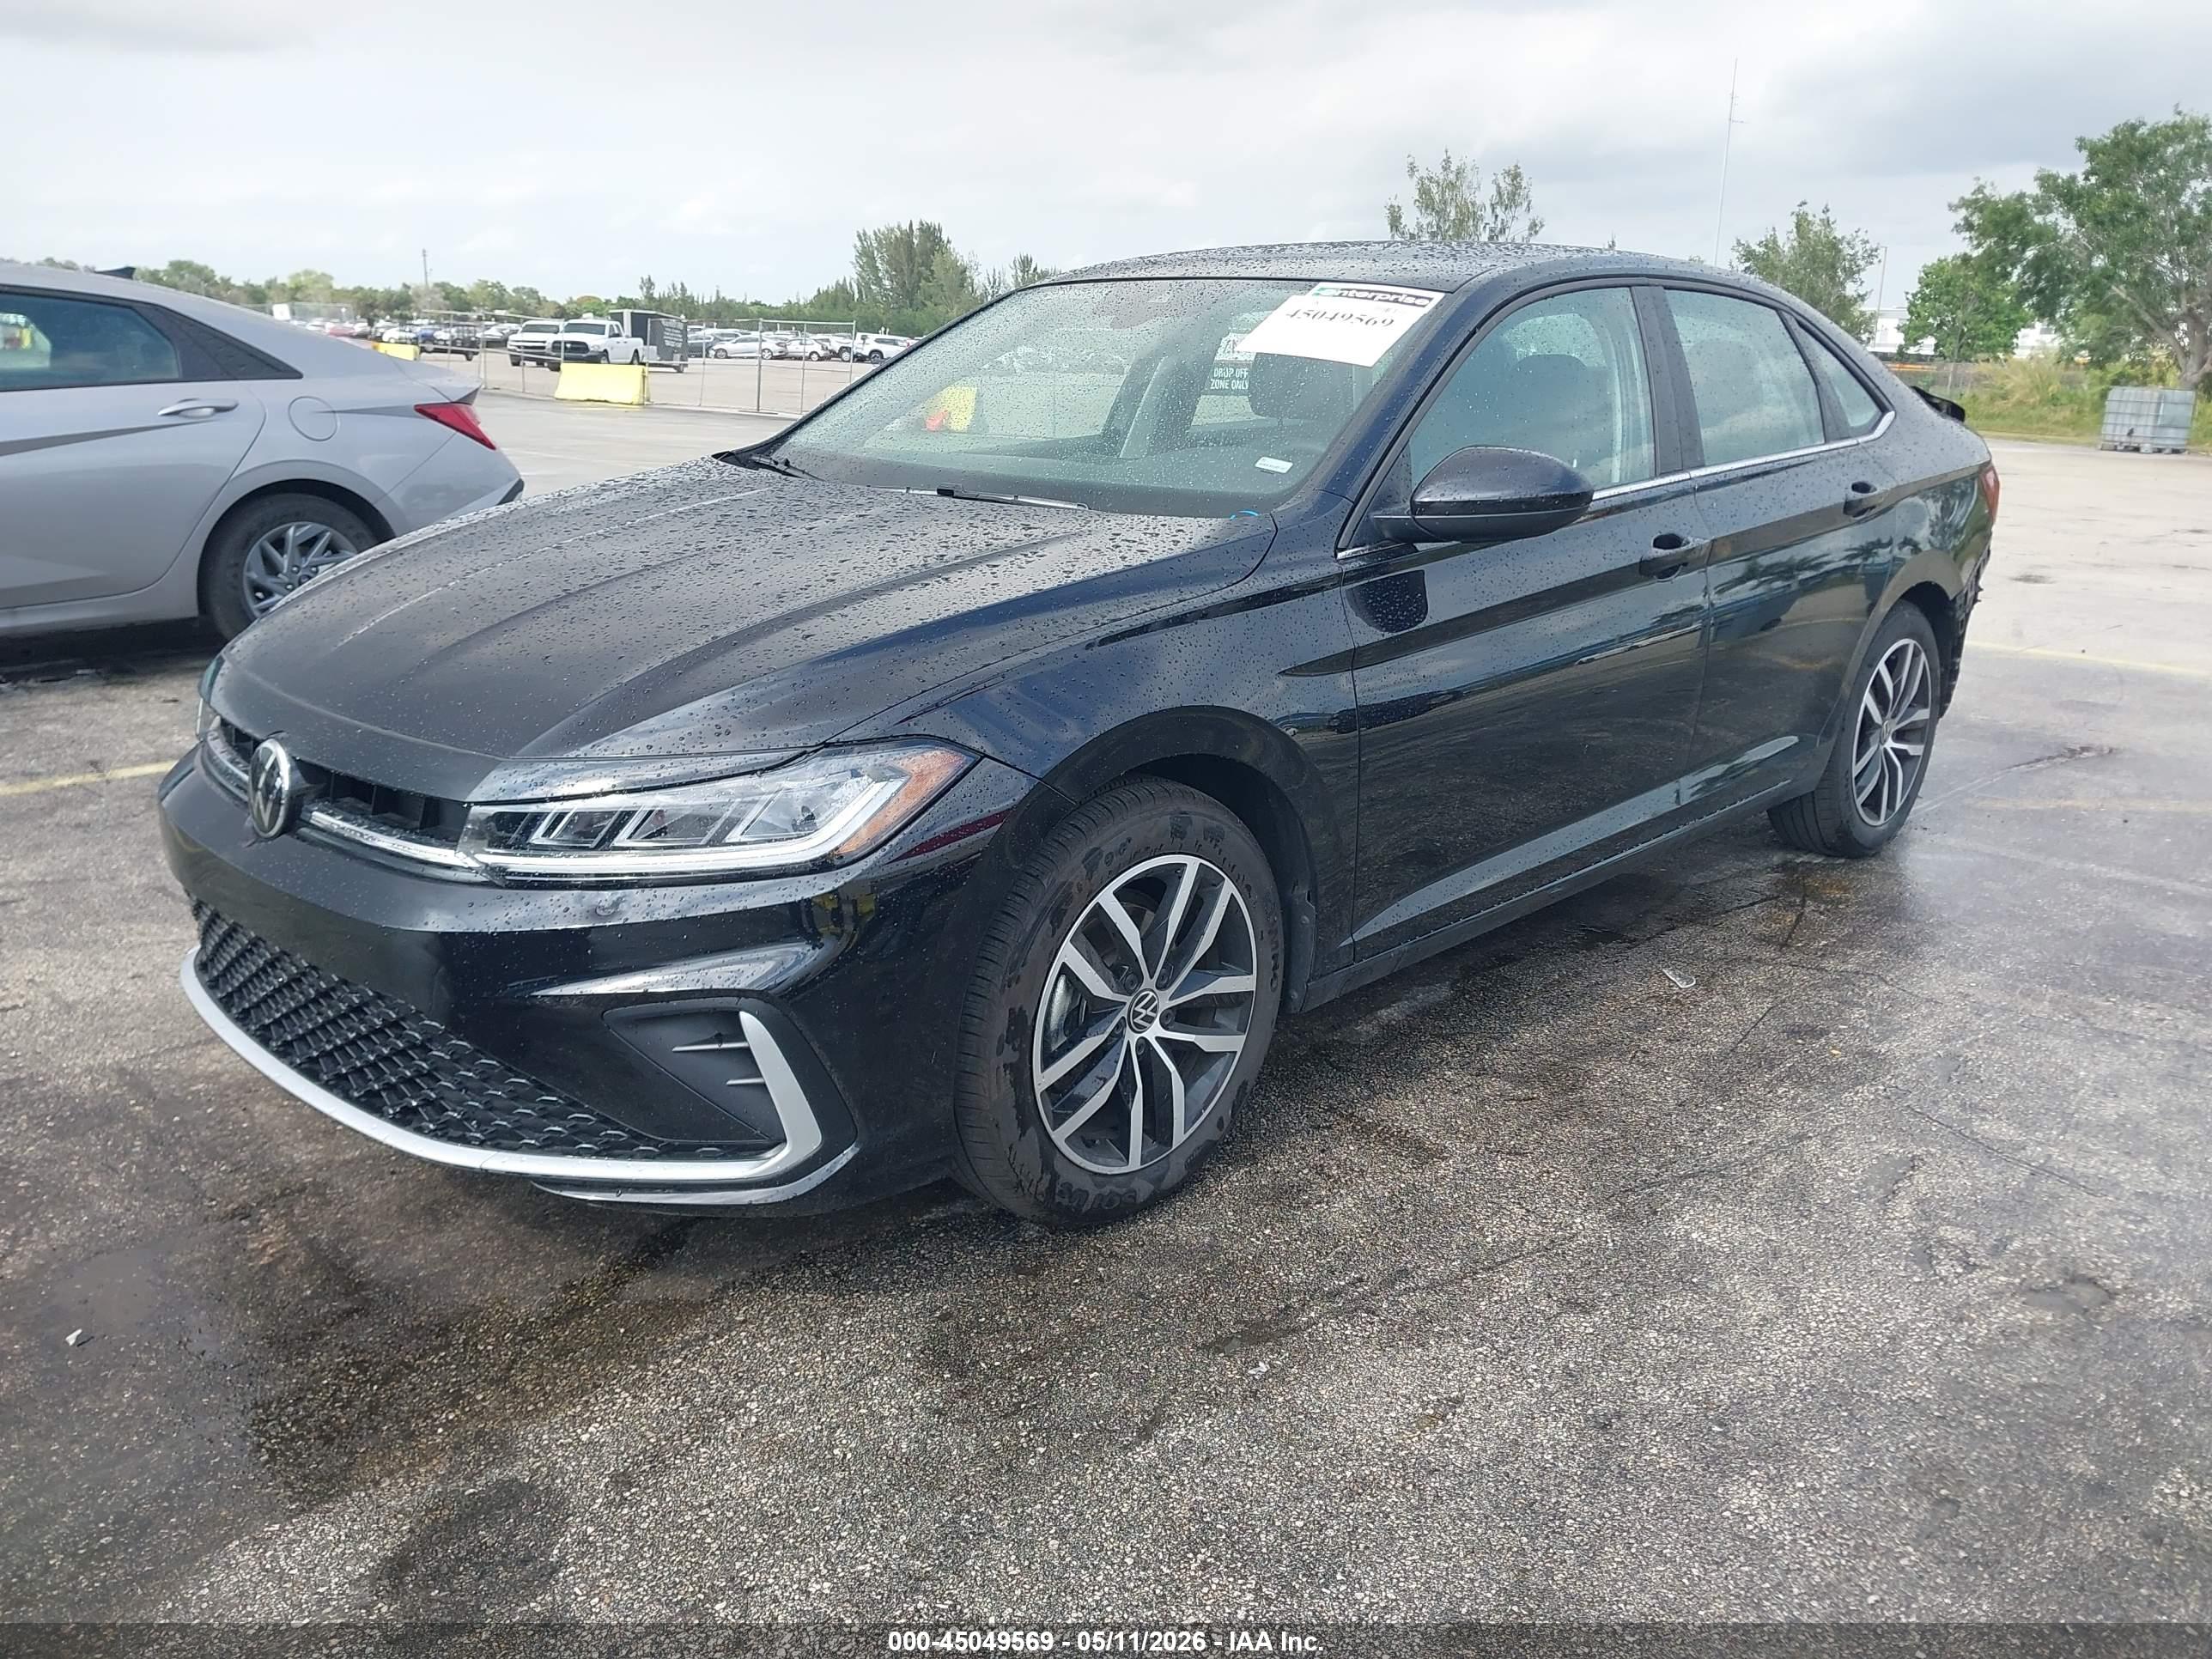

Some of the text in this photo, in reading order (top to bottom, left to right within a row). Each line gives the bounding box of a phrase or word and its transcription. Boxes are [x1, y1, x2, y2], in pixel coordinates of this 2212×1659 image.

[1286, 309, 1395, 327] 45049569
[1213, 367, 1249, 379] DROP OFF
[1210, 379, 1249, 390] ZONE ONLY
